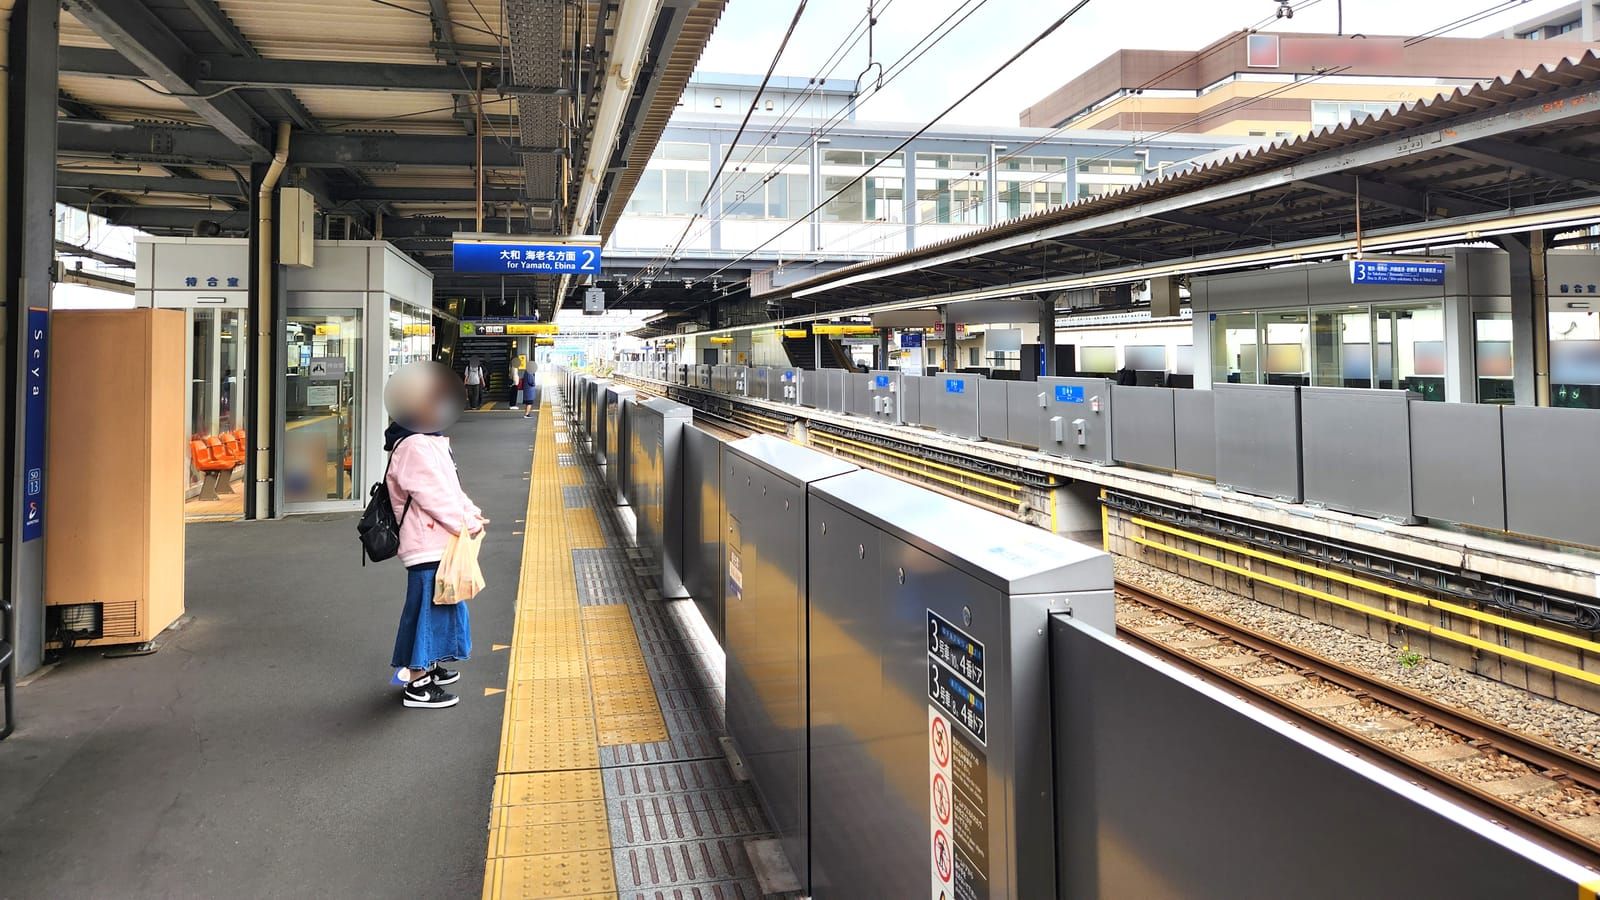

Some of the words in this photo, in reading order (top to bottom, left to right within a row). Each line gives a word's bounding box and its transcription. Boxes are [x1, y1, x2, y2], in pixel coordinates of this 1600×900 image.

[500, 250, 520, 260] 大和
[525, 250, 576, 261] 海老名方面
[581, 249, 595, 270] 2
[507, 261, 519, 269] for
[521, 261, 552, 270] Yamato,
[554, 261, 576, 270] Ebina
[1357, 264, 1366, 280] 3
[185, 276, 239, 287] 待合室
[31, 328, 43, 396] Seya
[30, 480, 39, 493] 13
